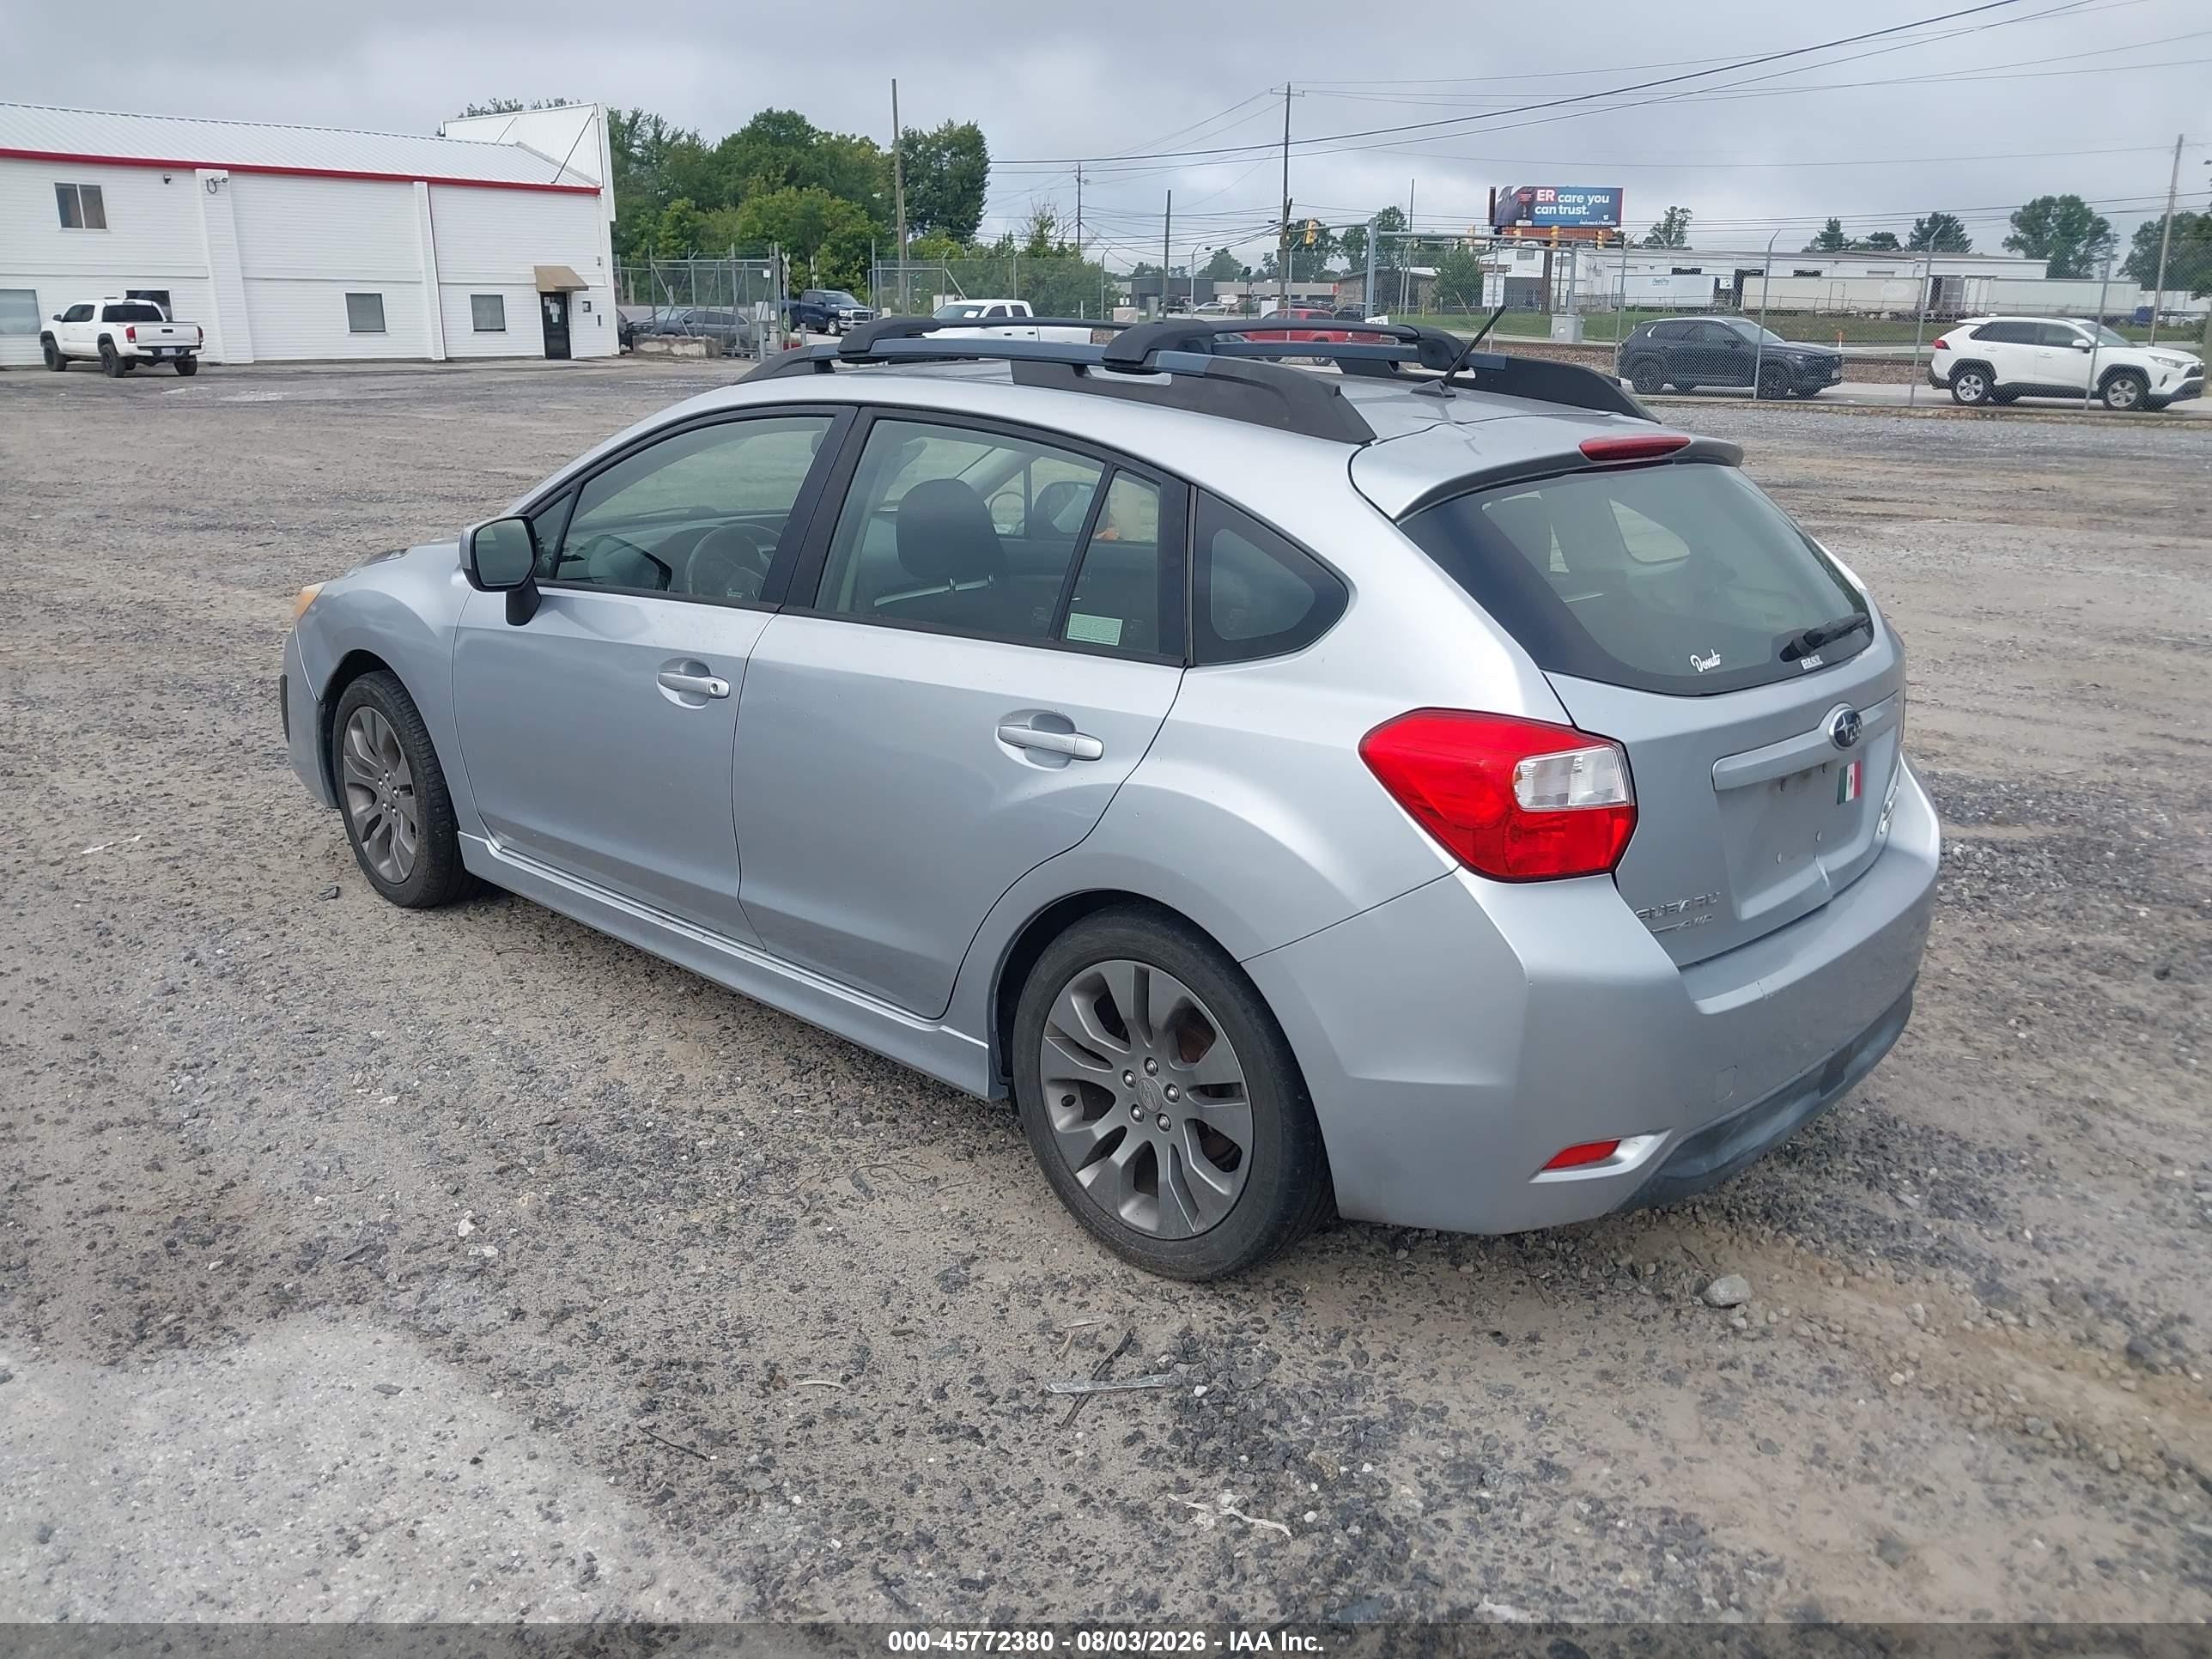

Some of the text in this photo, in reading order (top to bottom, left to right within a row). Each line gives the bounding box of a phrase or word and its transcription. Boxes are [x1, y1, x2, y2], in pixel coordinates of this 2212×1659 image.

[1537, 190, 1610, 206] ER care you
[1534, 204, 1590, 216] can trust.
